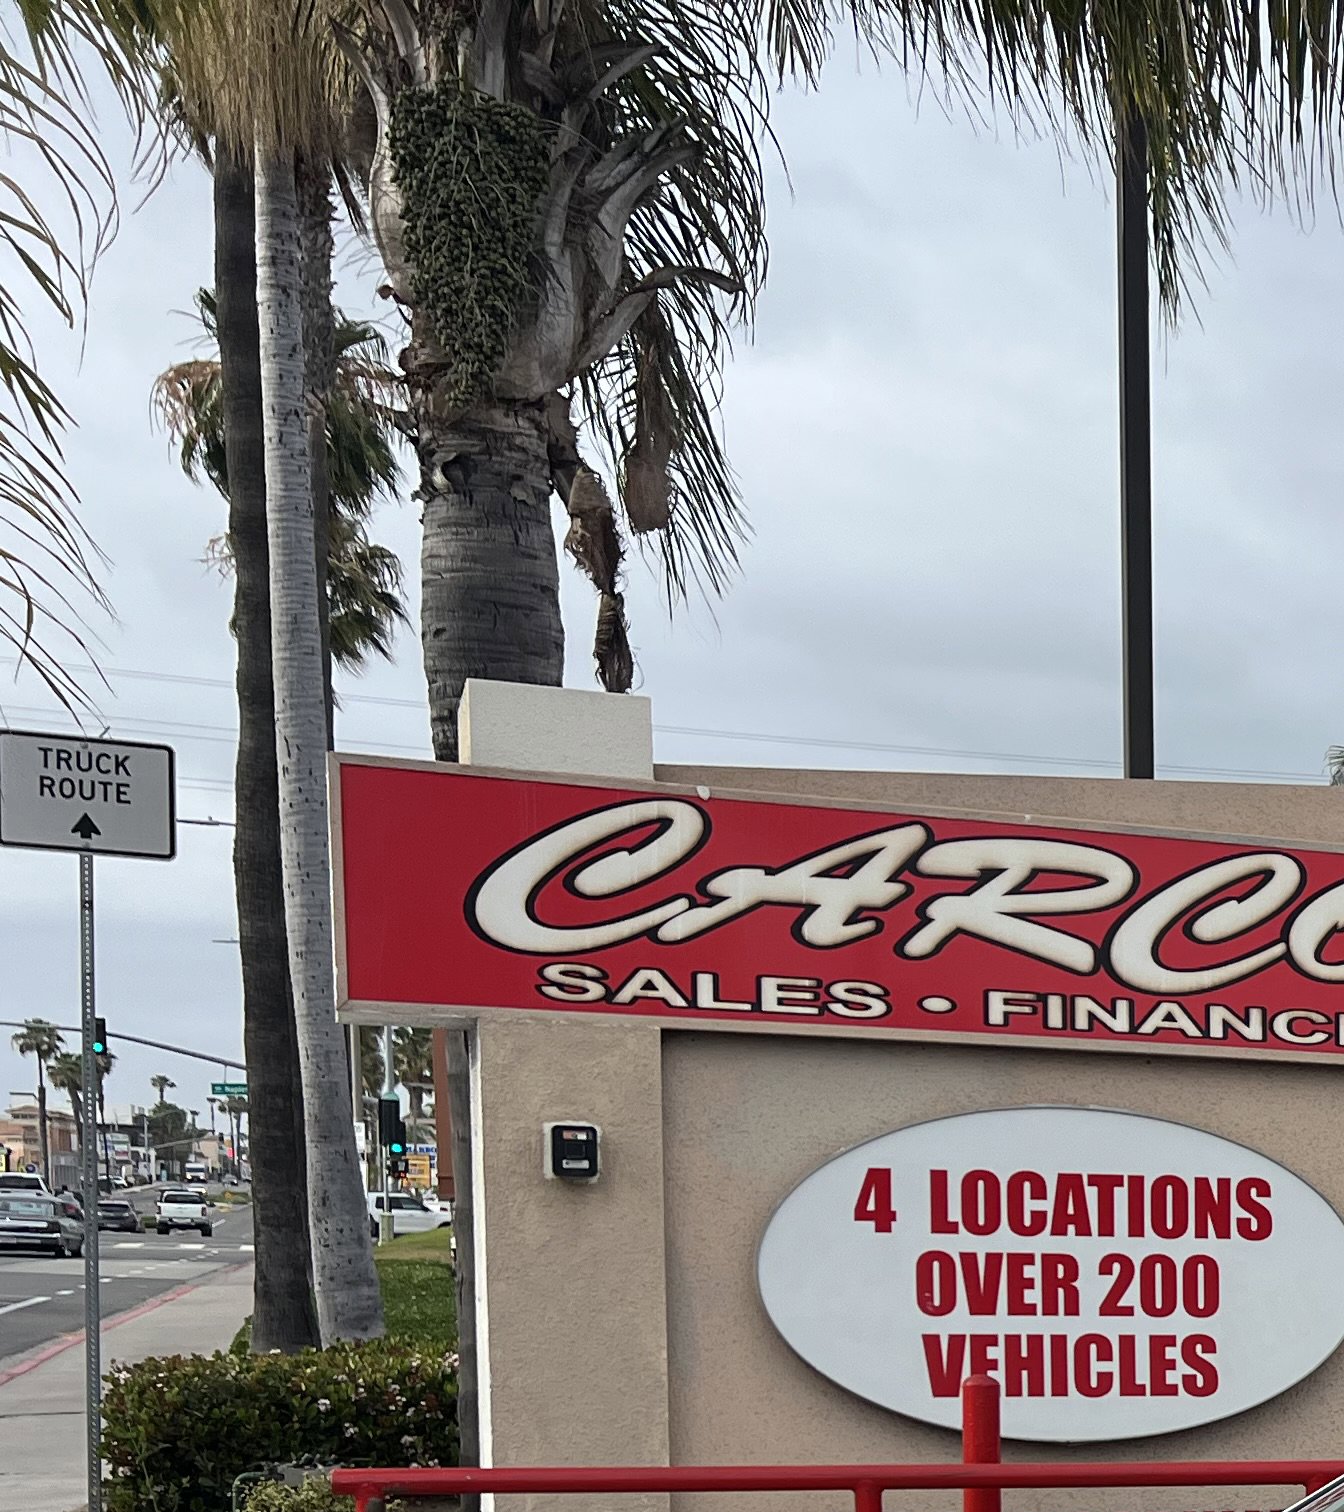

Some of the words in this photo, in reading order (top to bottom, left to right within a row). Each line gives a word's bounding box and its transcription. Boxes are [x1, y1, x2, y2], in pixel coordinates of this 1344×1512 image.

[38, 746, 132, 777] TRUCK
[39, 775, 132, 804] ROUTE
[539, 962, 891, 1020] SALES
[853, 1167, 897, 1233] 4
[929, 1168, 1274, 1242] LOCATIONS
[915, 1249, 1081, 1317] OVER
[1097, 1252, 1221, 1319] 200
[921, 1332, 1220, 1399] VEHICLES
